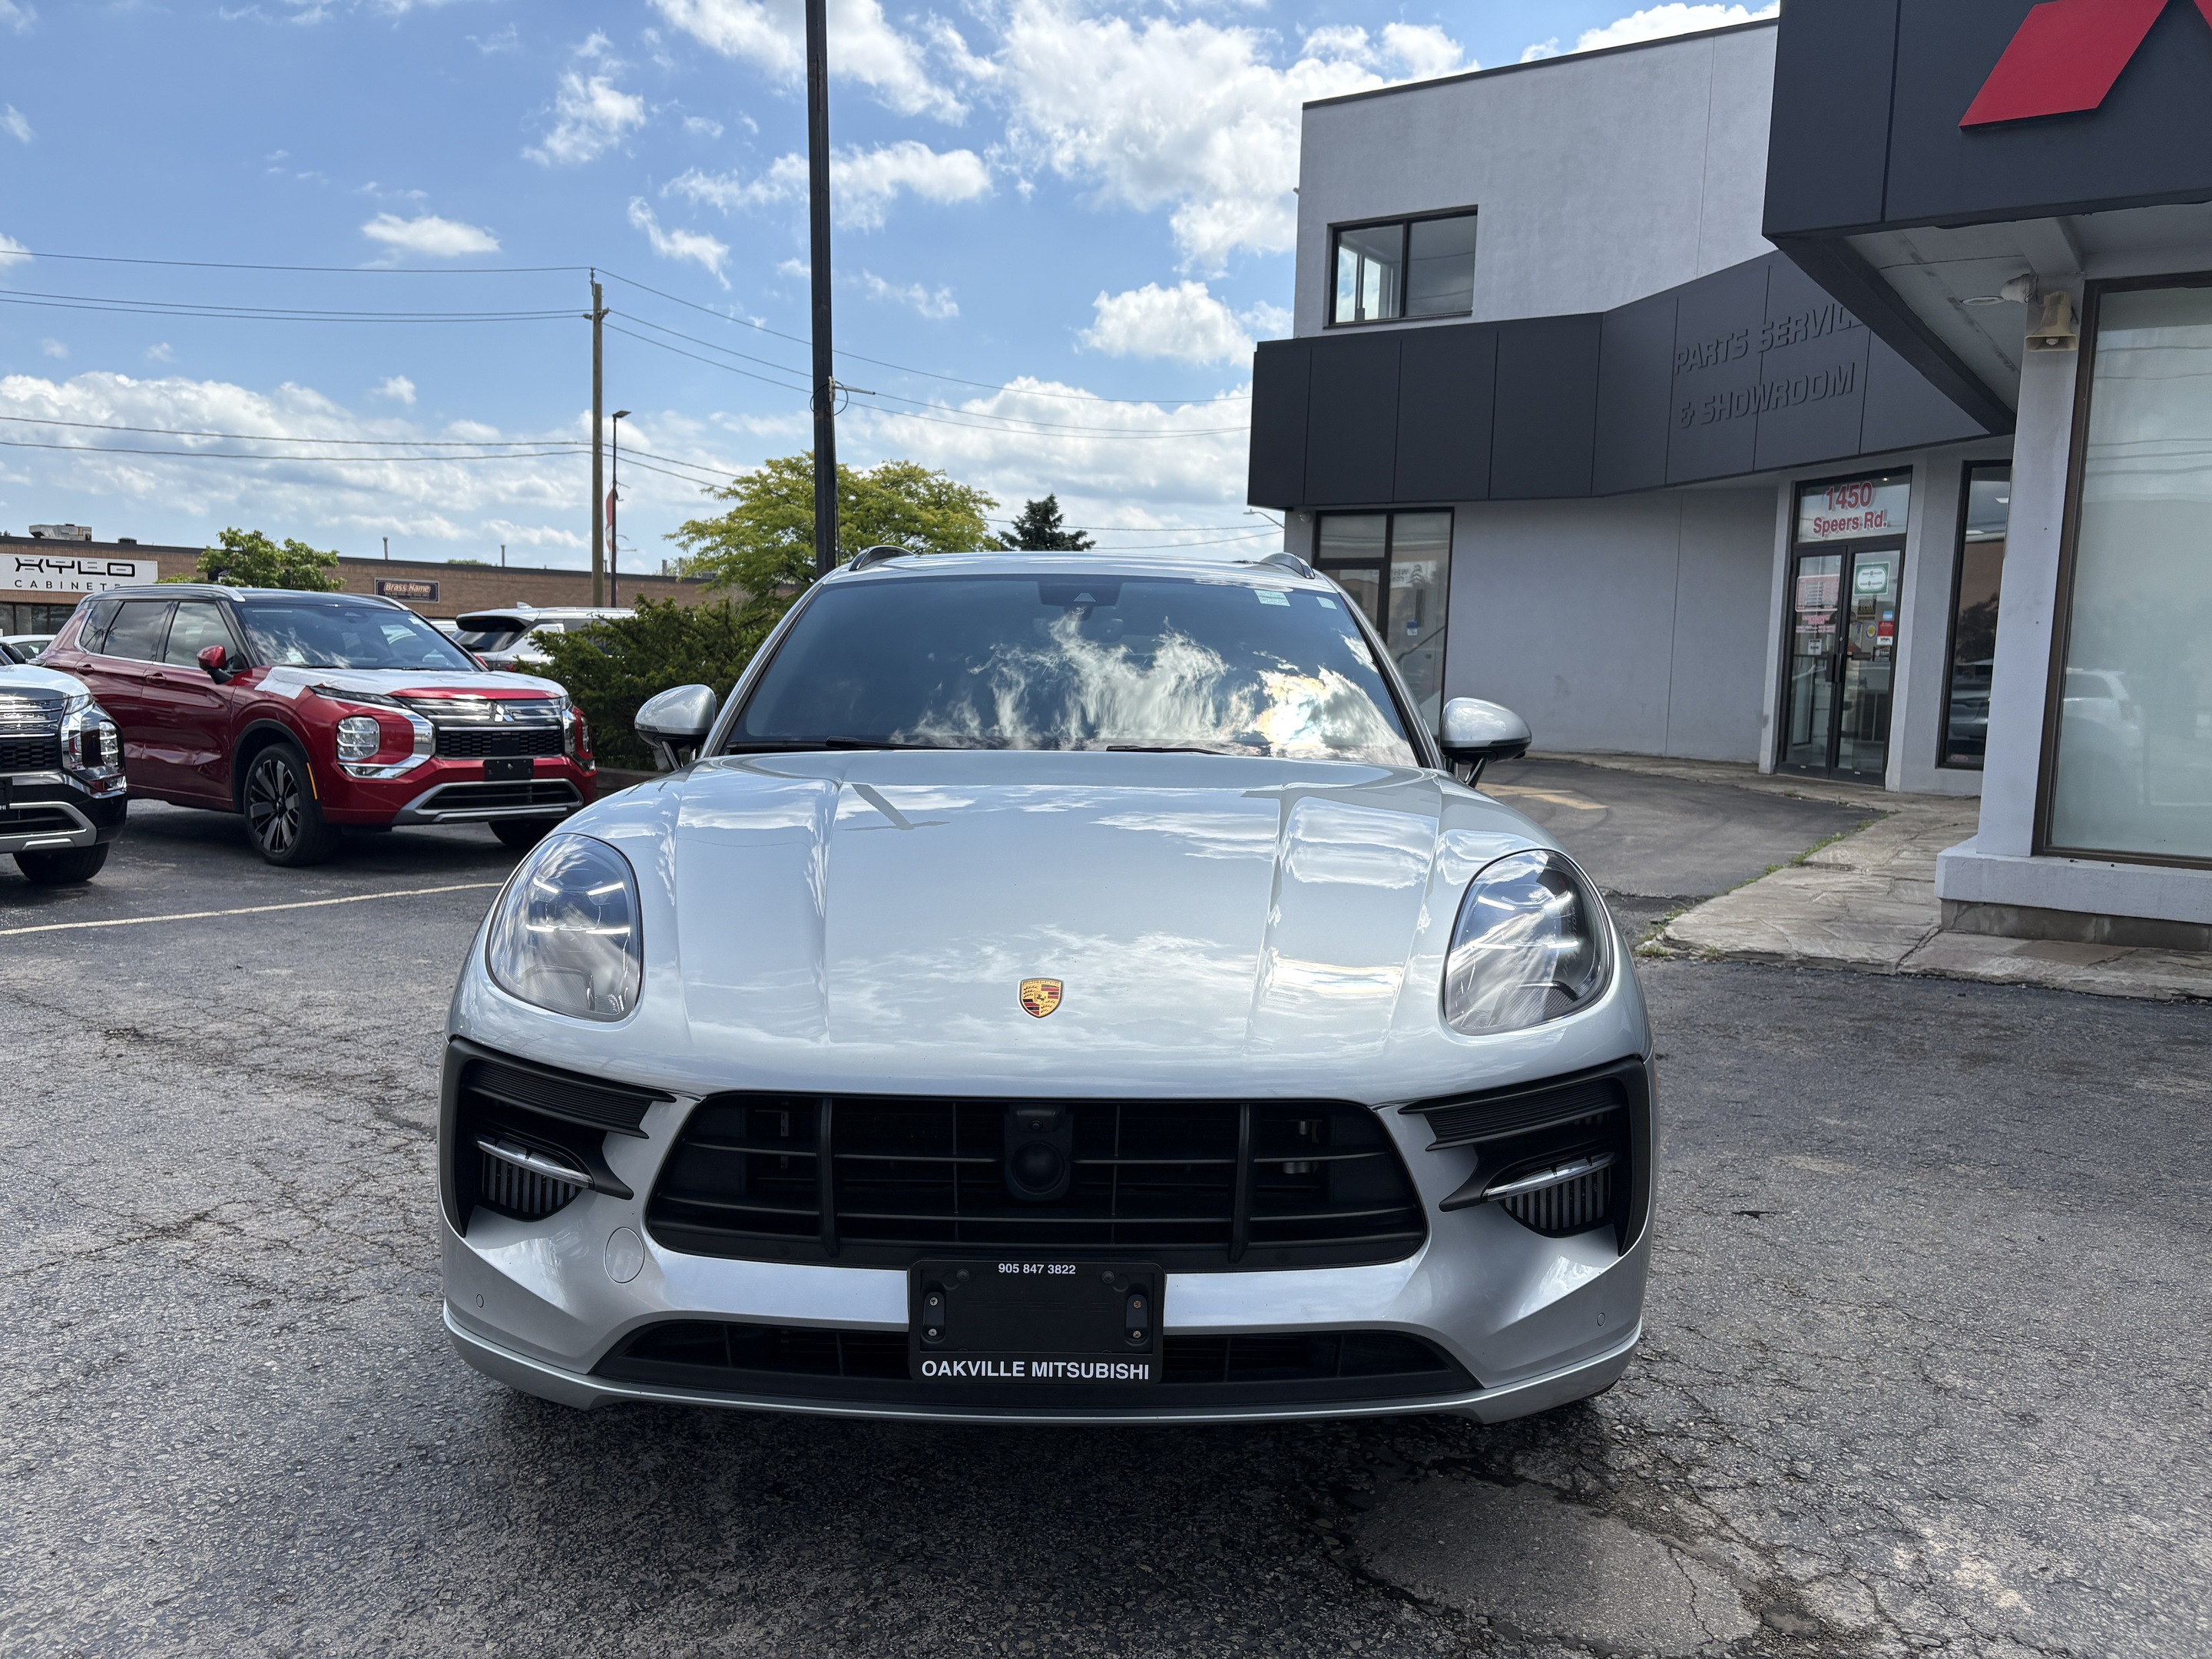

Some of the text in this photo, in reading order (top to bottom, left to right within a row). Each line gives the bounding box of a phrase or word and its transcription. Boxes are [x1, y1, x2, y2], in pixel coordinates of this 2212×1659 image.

[1675, 303, 1864, 376] PARTS SERVIC
[1681, 362, 1856, 430] & SHOWROOM
[1825, 481, 1873, 512] 1450
[1813, 509, 1887, 538] Speers Rd.
[384, 582, 431, 593] Brass Name
[998, 1263, 1076, 1275] 905 847 3822
[922, 1360, 1149, 1380] OAKVILLE MITSUBISHI
